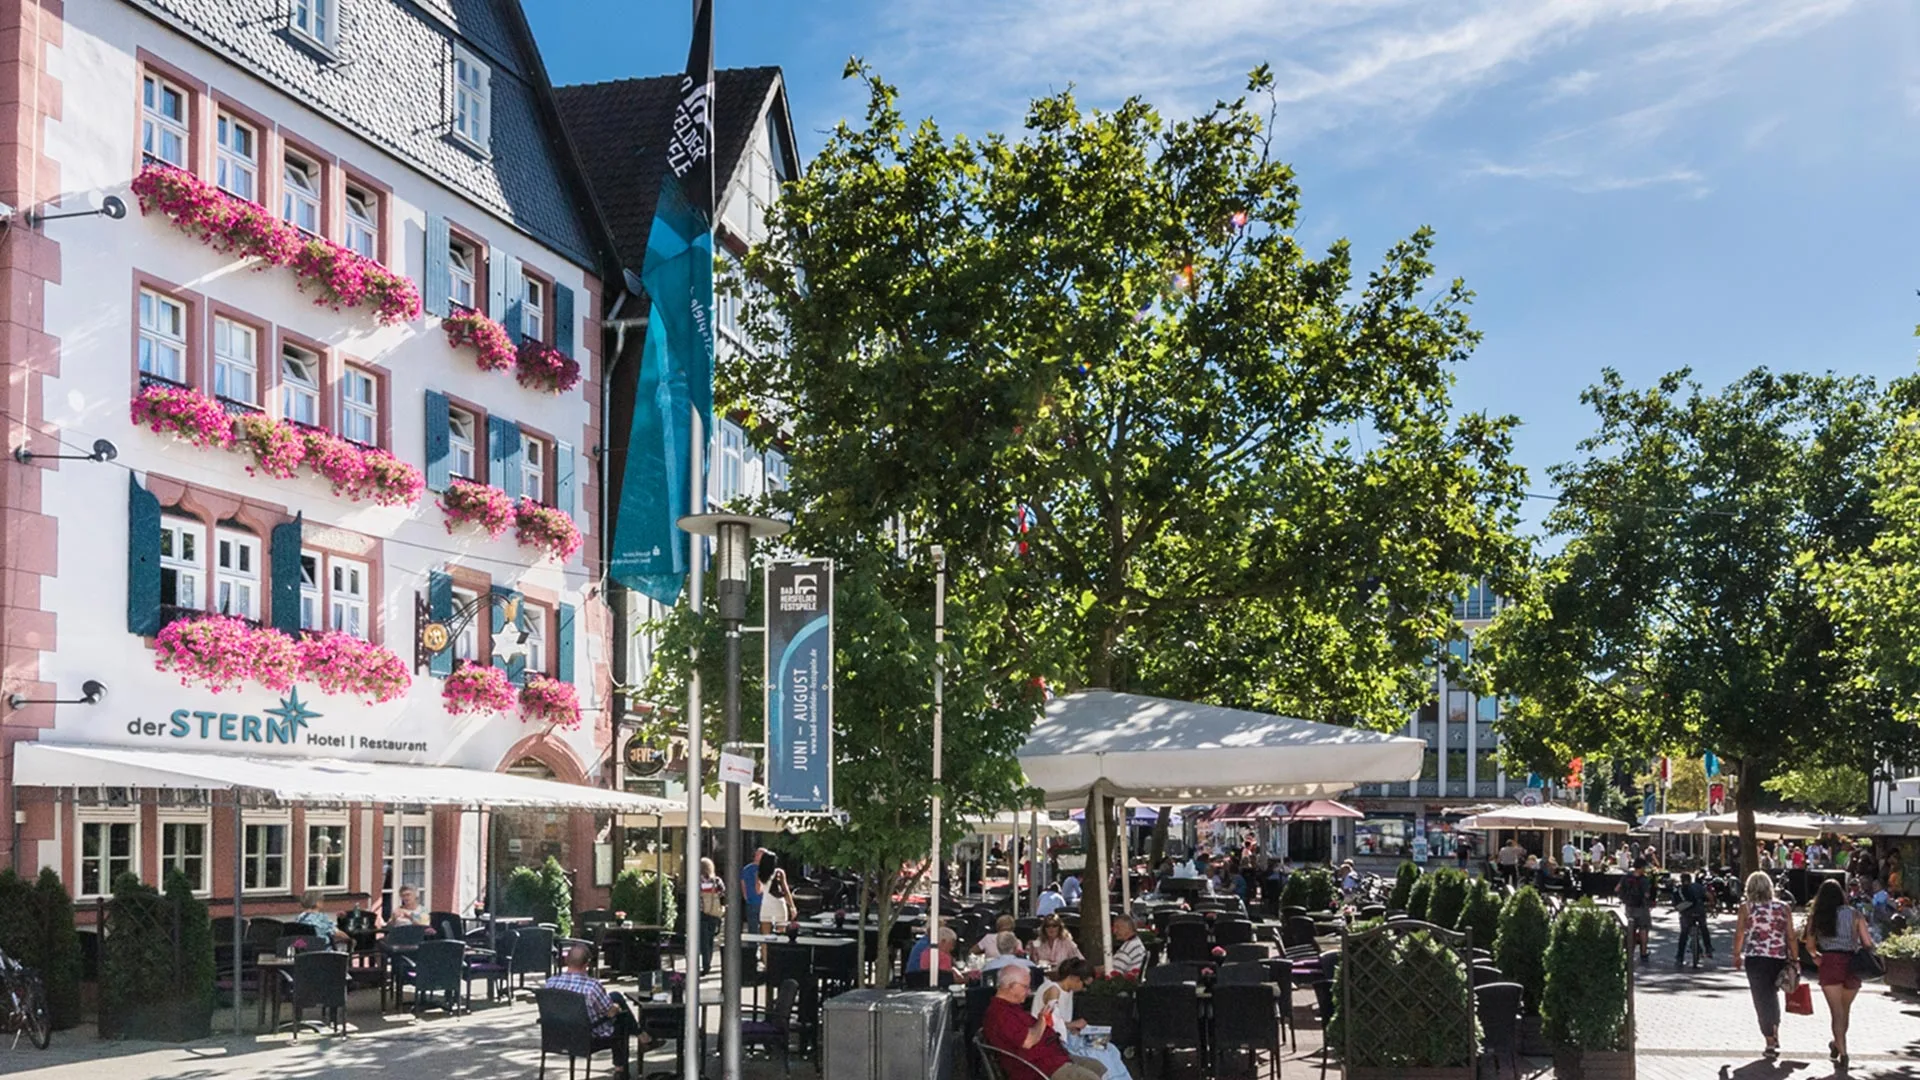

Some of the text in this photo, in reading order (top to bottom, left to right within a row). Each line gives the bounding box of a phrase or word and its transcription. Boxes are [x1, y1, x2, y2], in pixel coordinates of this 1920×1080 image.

[780, 586, 793, 595] BAD
[780, 602, 817, 611] FESTSPIELE
[793, 668, 808, 721] AUGUST
[127, 709, 291, 744] der STERN
[307, 733, 345, 747] Hotel
[360, 736, 427, 752] Restaurant
[793, 741, 808, 771] JUNI
